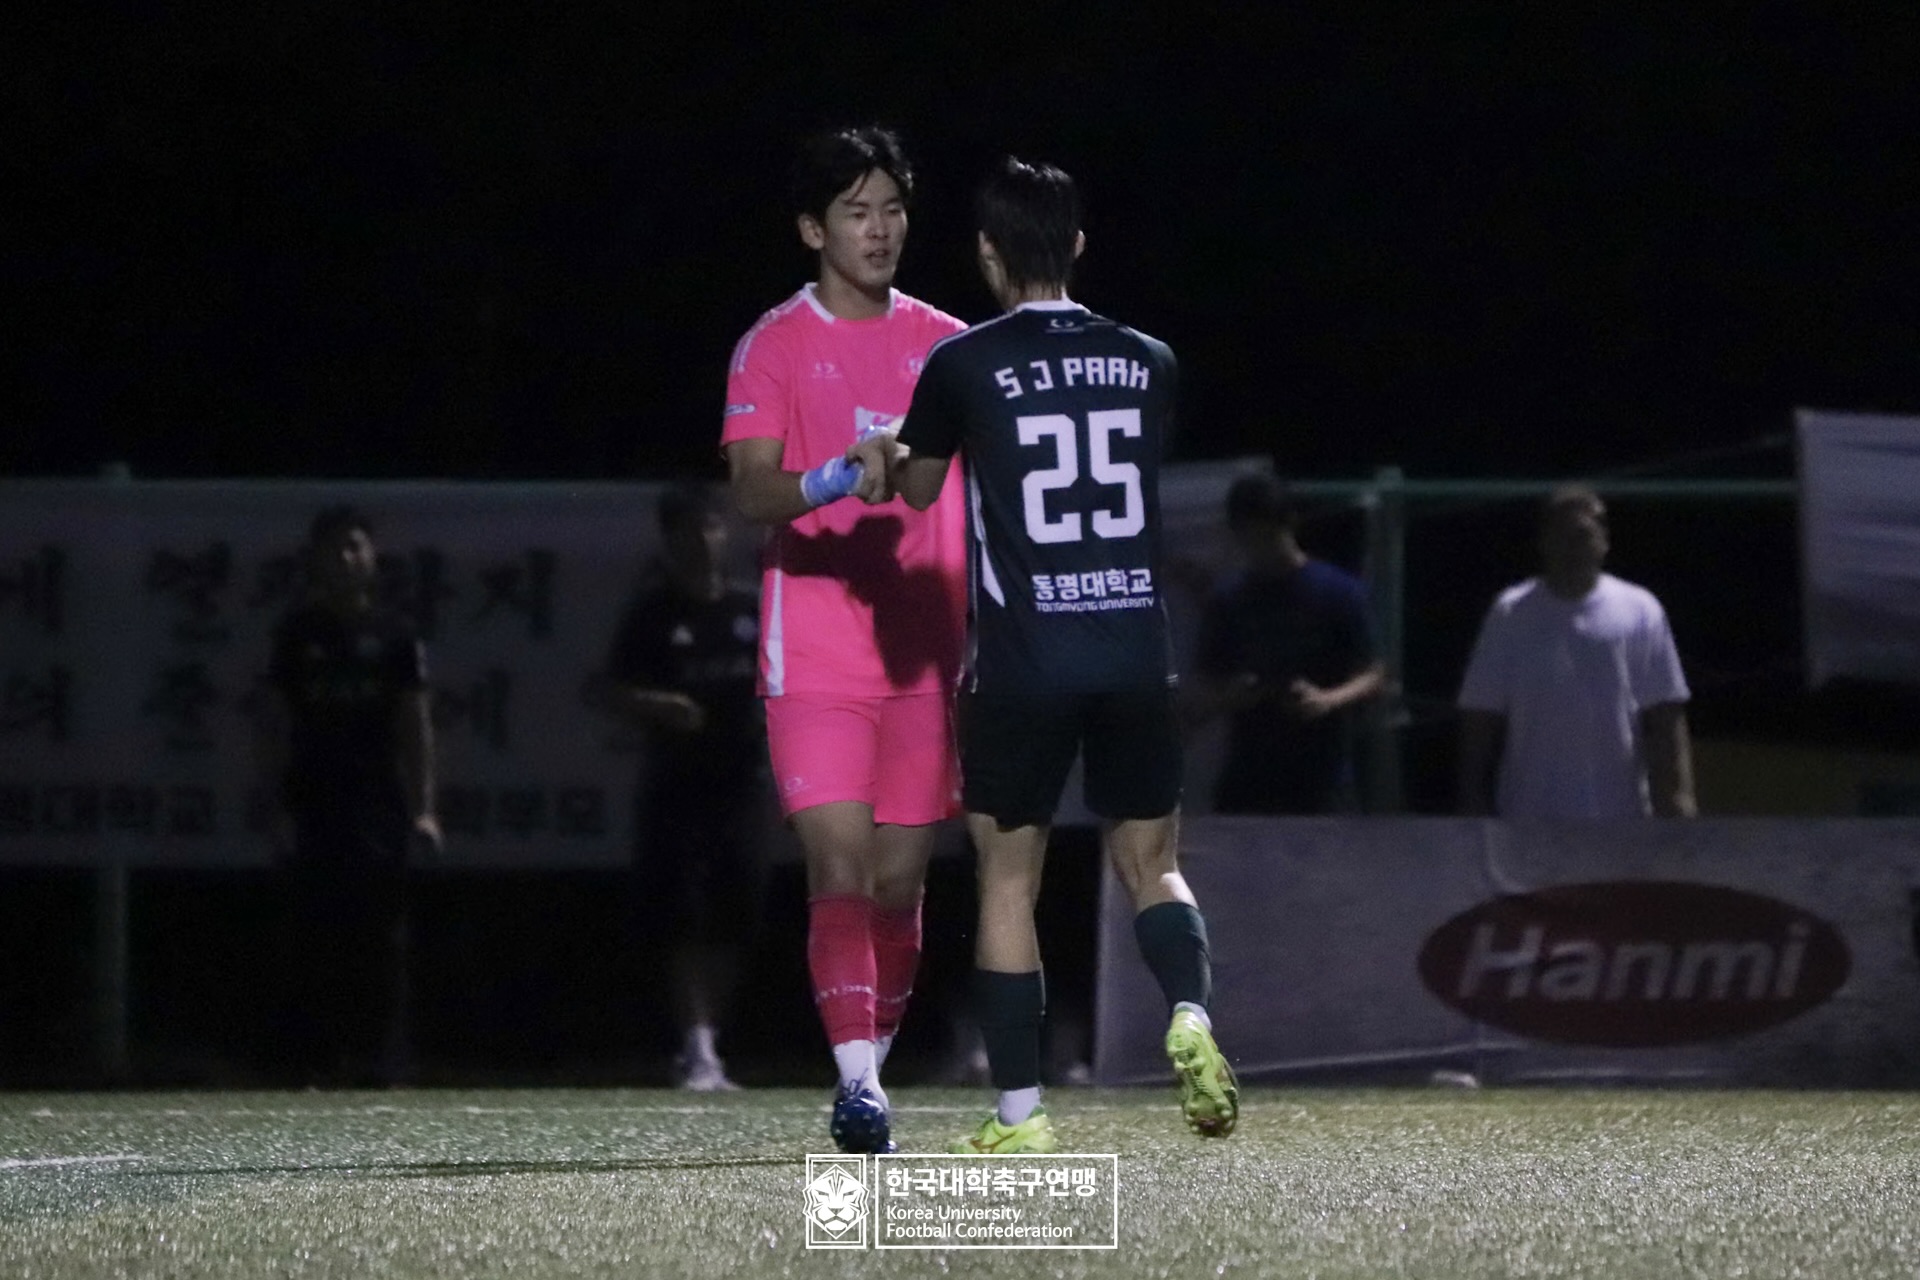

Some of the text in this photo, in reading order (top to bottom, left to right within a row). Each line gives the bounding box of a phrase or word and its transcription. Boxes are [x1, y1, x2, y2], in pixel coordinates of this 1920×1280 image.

[994, 366, 1024, 399] S
[1029, 359, 1054, 391] J
[1016, 408, 1145, 544] 25
[1032, 568, 1153, 601] 동명대학교
[1100, 596, 1154, 610] UNIVERSITY
[1458, 921, 1811, 1000] Hanmi
